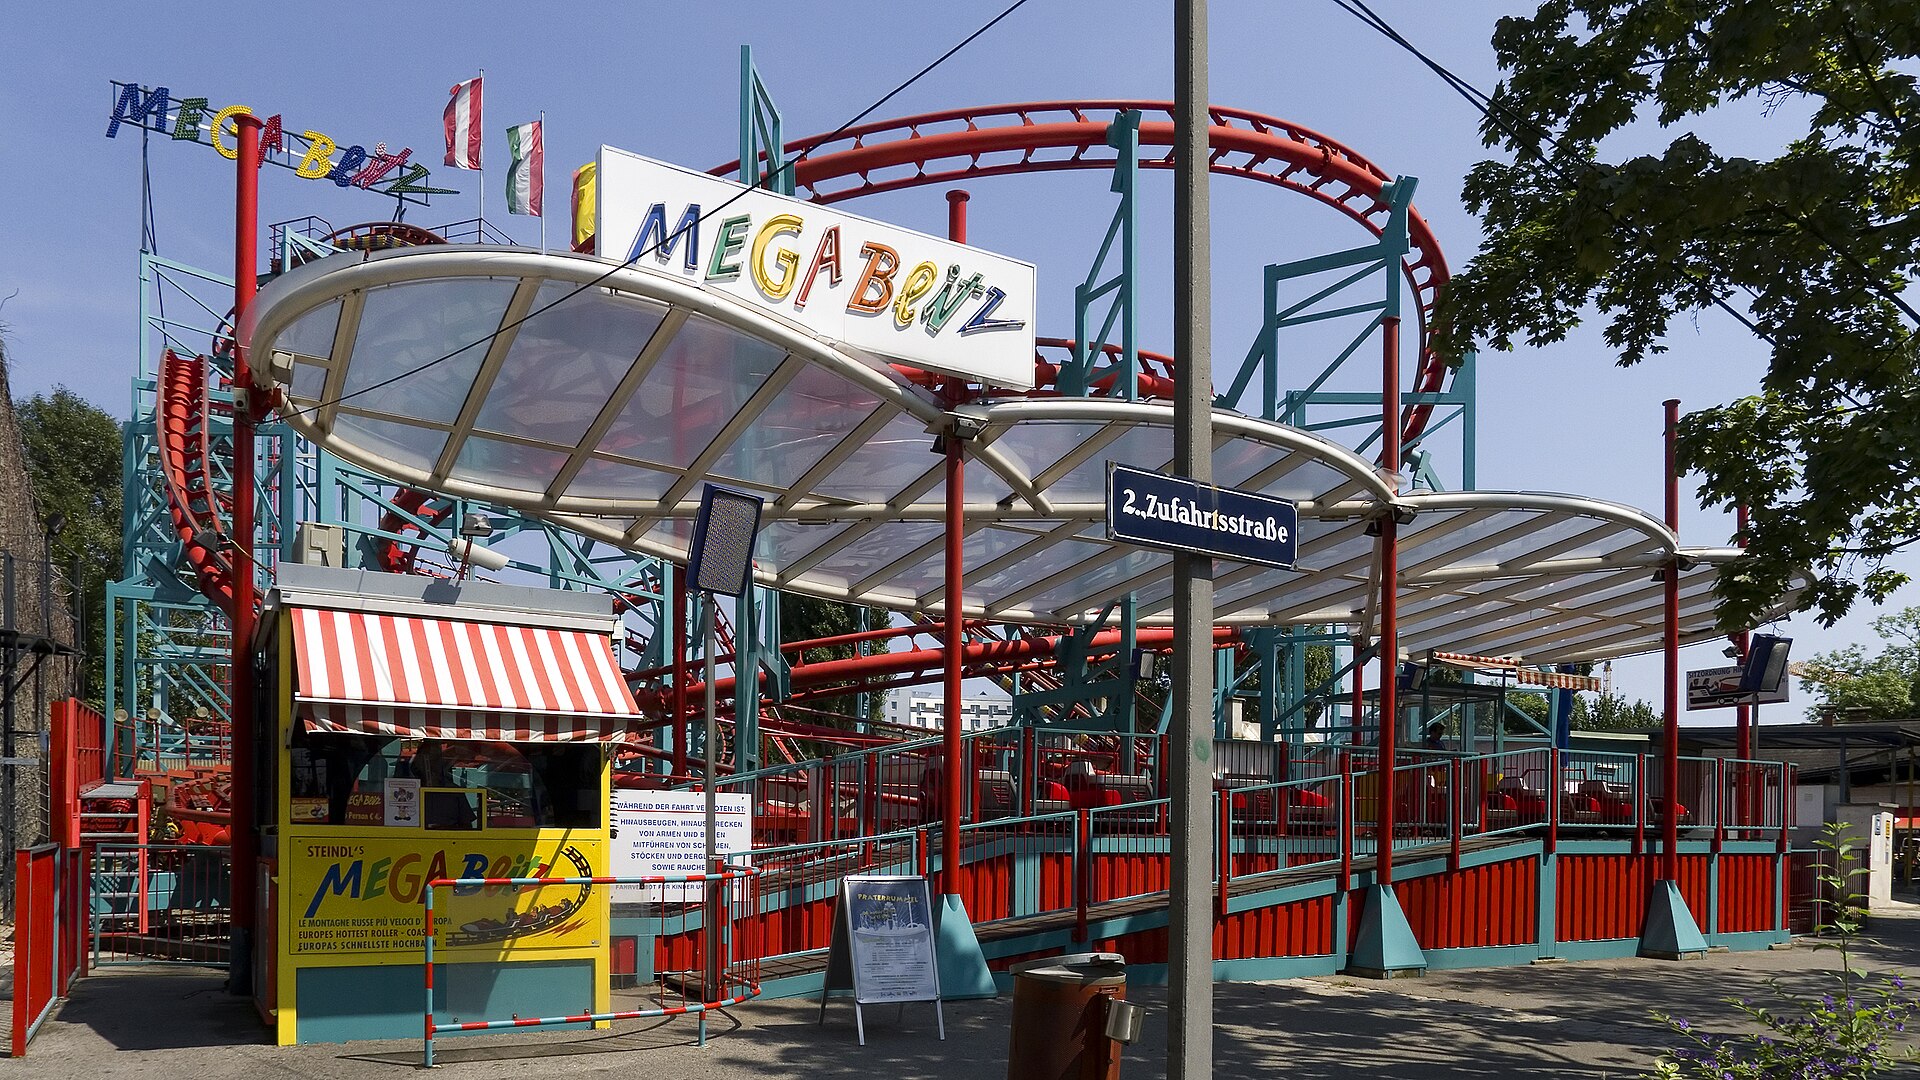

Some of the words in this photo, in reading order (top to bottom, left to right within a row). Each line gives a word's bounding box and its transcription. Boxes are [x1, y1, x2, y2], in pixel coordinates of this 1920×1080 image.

[105, 82, 283, 169] MEGA
[624, 201, 843, 308] MEGA
[346, 794, 364, 807] EGA
[617, 801, 654, 810] WÄHREND
[681, 820, 743, 828] HINAUSRECKEN
[632, 840, 675, 849] MITFÜHREN
[693, 842, 732, 850] SCHMEN,
[630, 852, 666, 860] STÖCKEN
[651, 863, 675, 871] SOWIE
[303, 850, 449, 919] MEGA
[298, 919, 307, 928] LE
[307, 918, 350, 928] MONTAGNE
[351, 918, 374, 927] RUSSE
[389, 917, 414, 926] VELOCI
[298, 929, 334, 939] EUROPES
[335, 929, 369, 938] HOTTEST
[371, 928, 399, 937] ROLLER
[406, 928, 439, 937] COASR
[298, 942, 337, 951] EUROPAS
[341, 940, 390, 950] SCHNELLSTE
[392, 939, 438, 949] HOCHBAN
